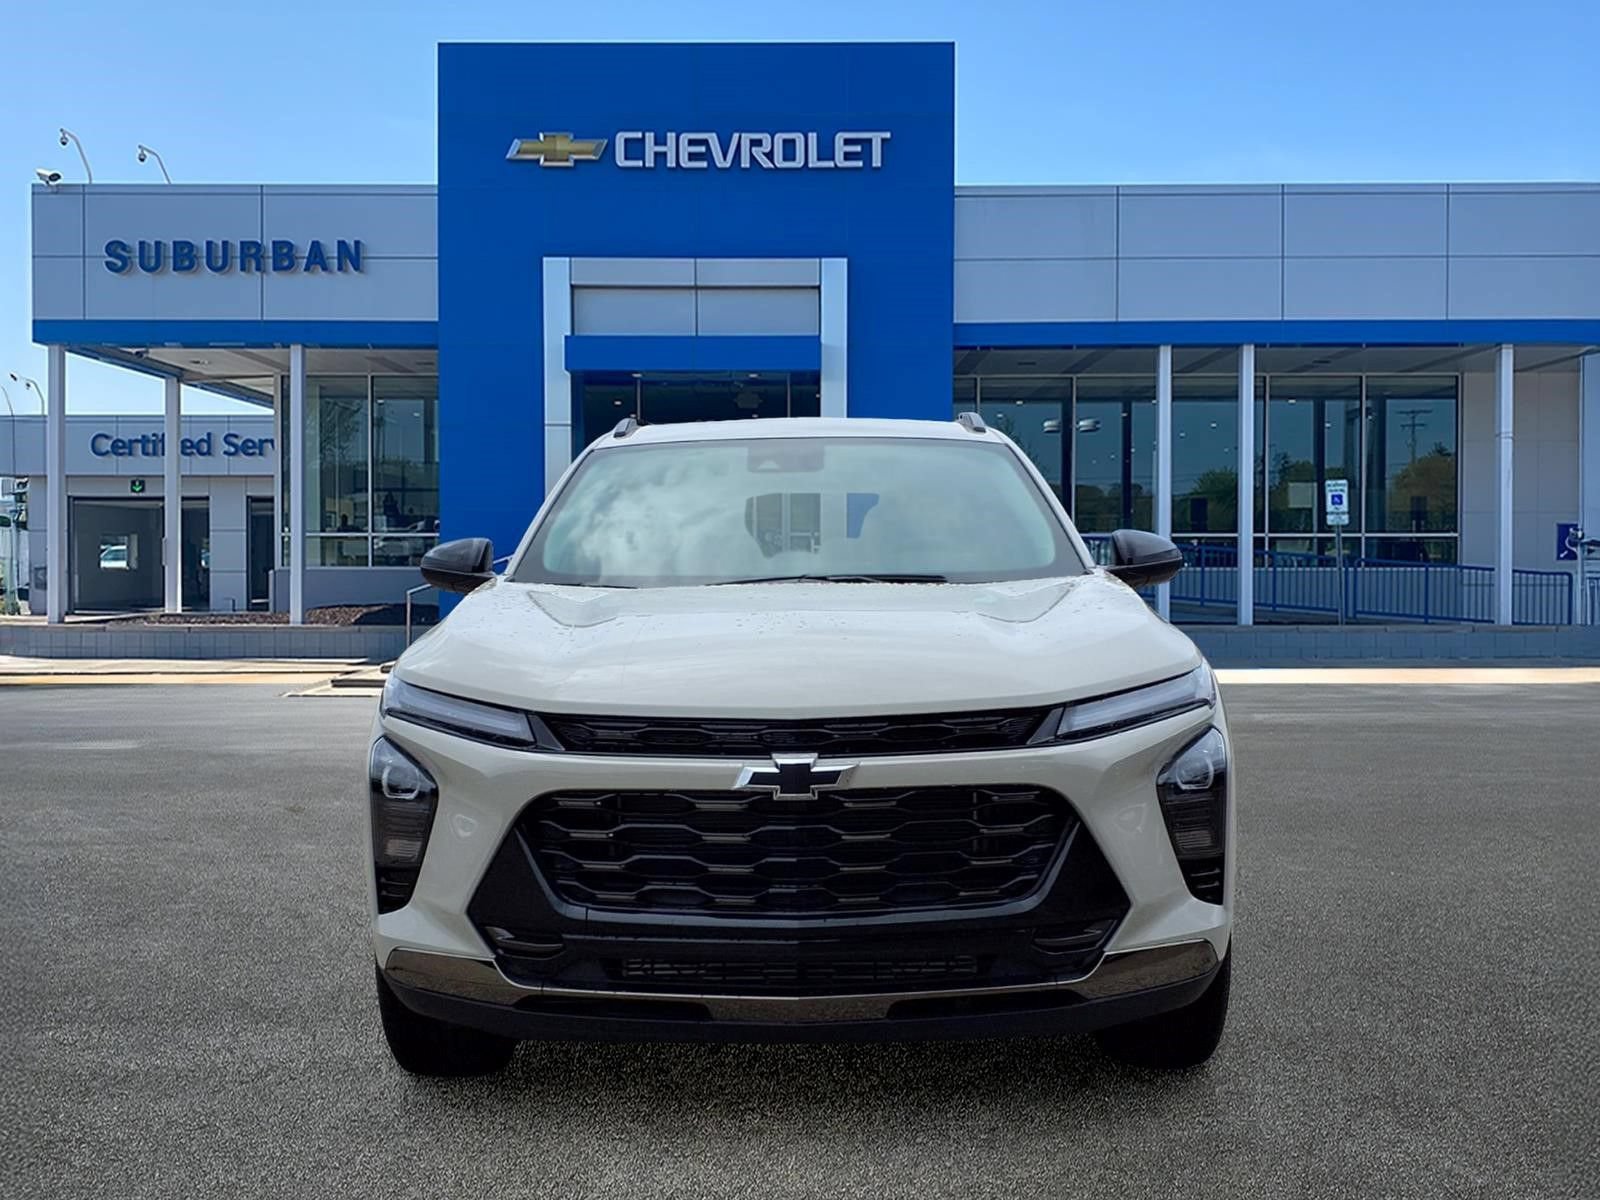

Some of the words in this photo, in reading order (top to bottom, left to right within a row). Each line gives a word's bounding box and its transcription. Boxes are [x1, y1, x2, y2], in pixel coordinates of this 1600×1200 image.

[615, 131, 891, 169] CHEVROLET
[104, 239, 362, 274] SUBURBAN
[90, 432, 213, 457] Certifed
